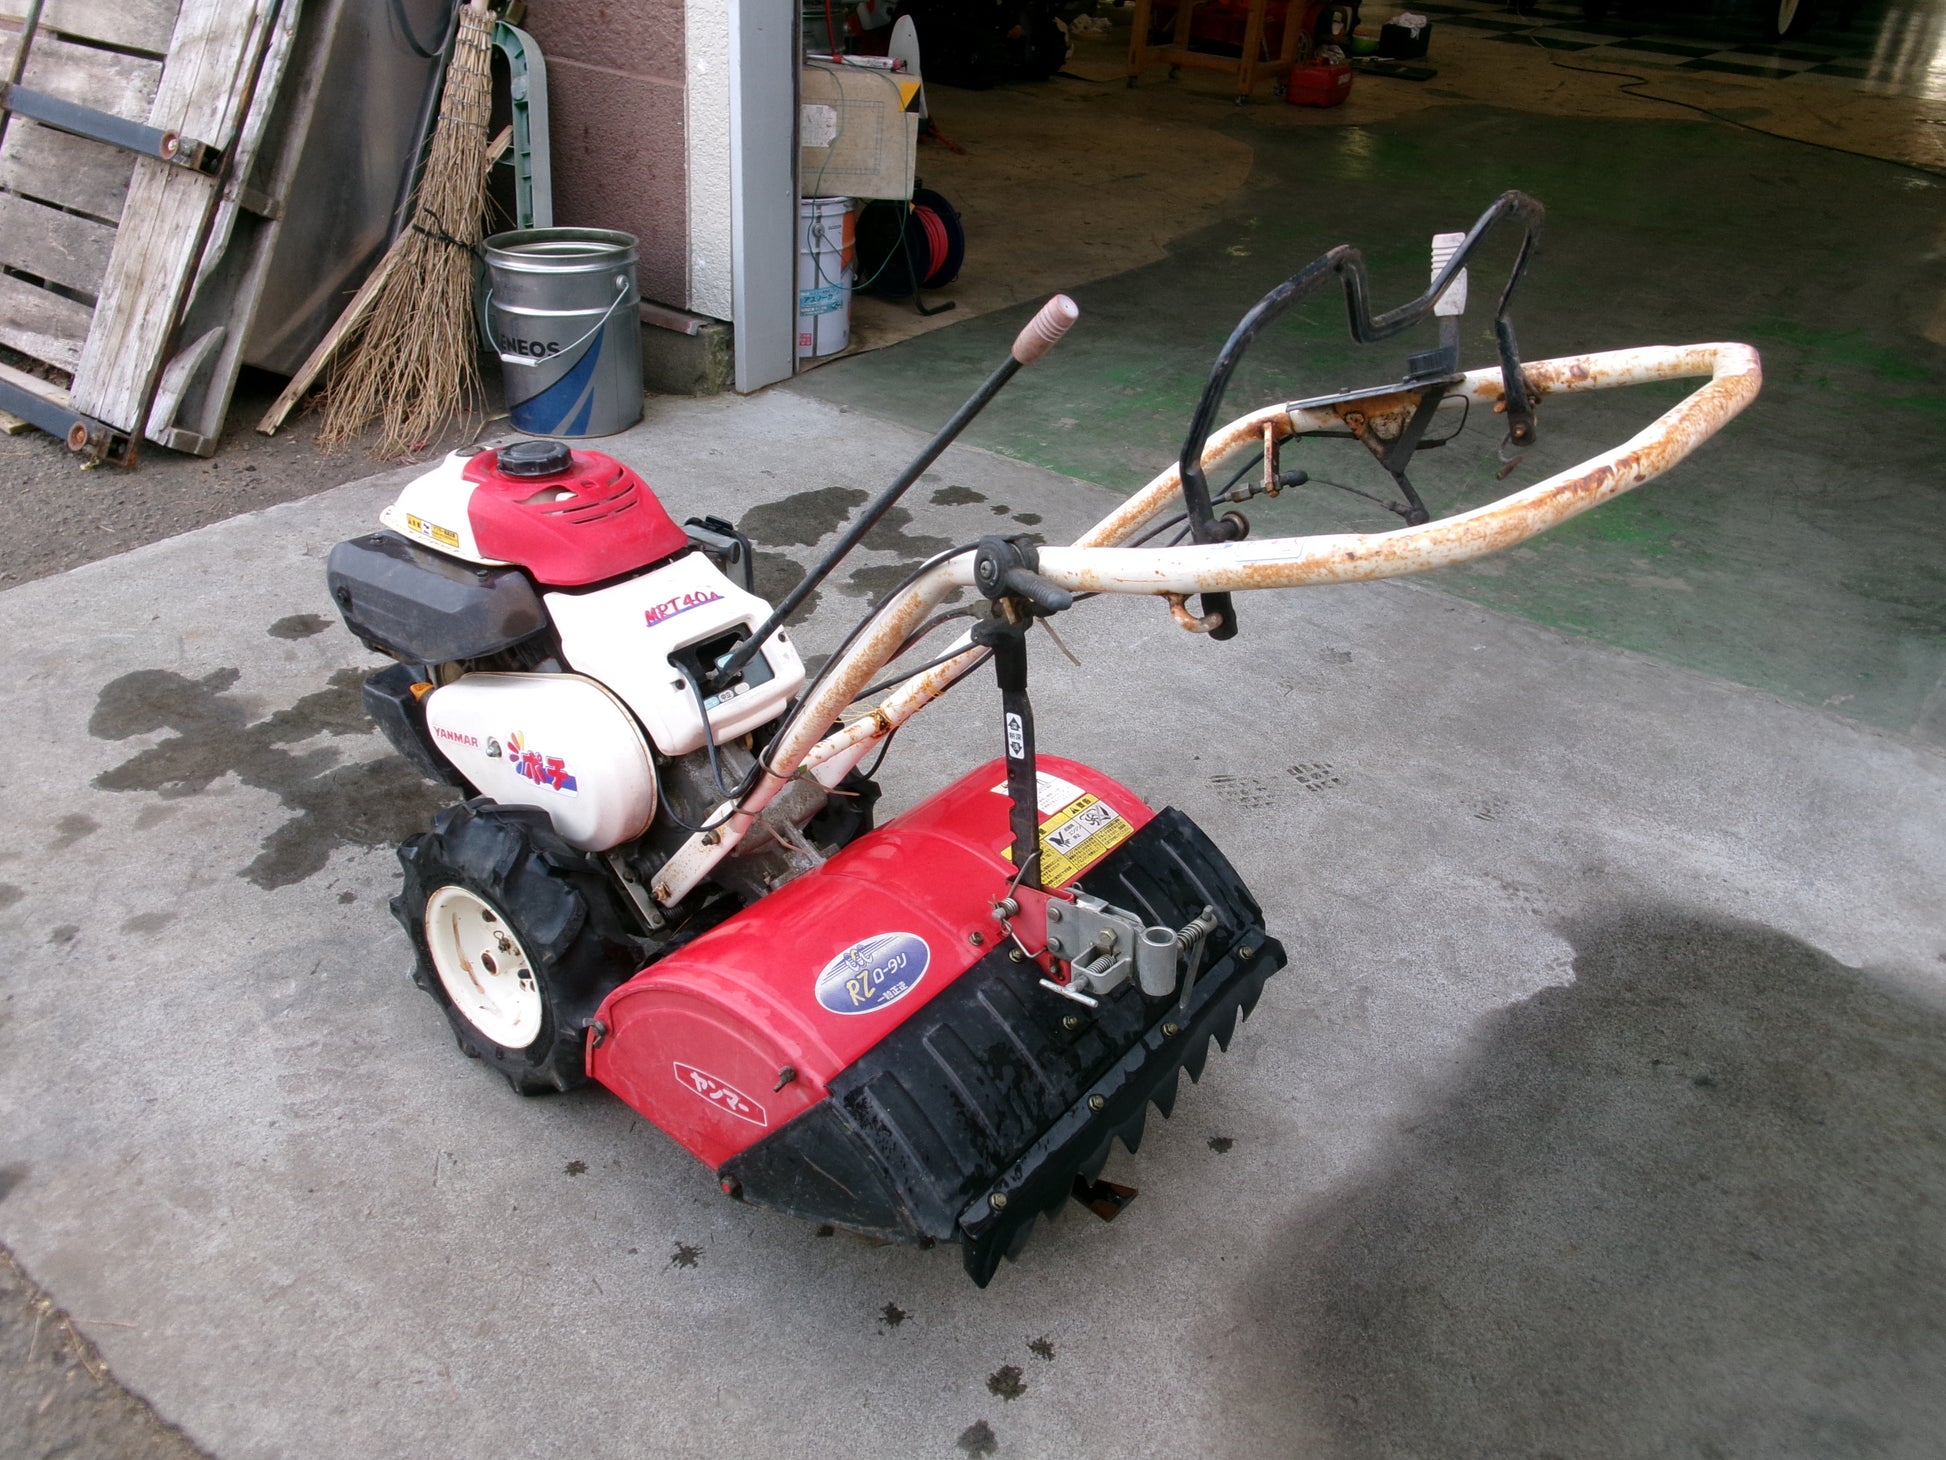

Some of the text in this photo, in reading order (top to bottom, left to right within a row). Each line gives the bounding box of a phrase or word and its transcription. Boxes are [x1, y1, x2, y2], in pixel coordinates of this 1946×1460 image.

[501, 334, 561, 359] ENEOS
[433, 726, 479, 748] YANMAR
[690, 1071, 750, 1113] ヤンマー
